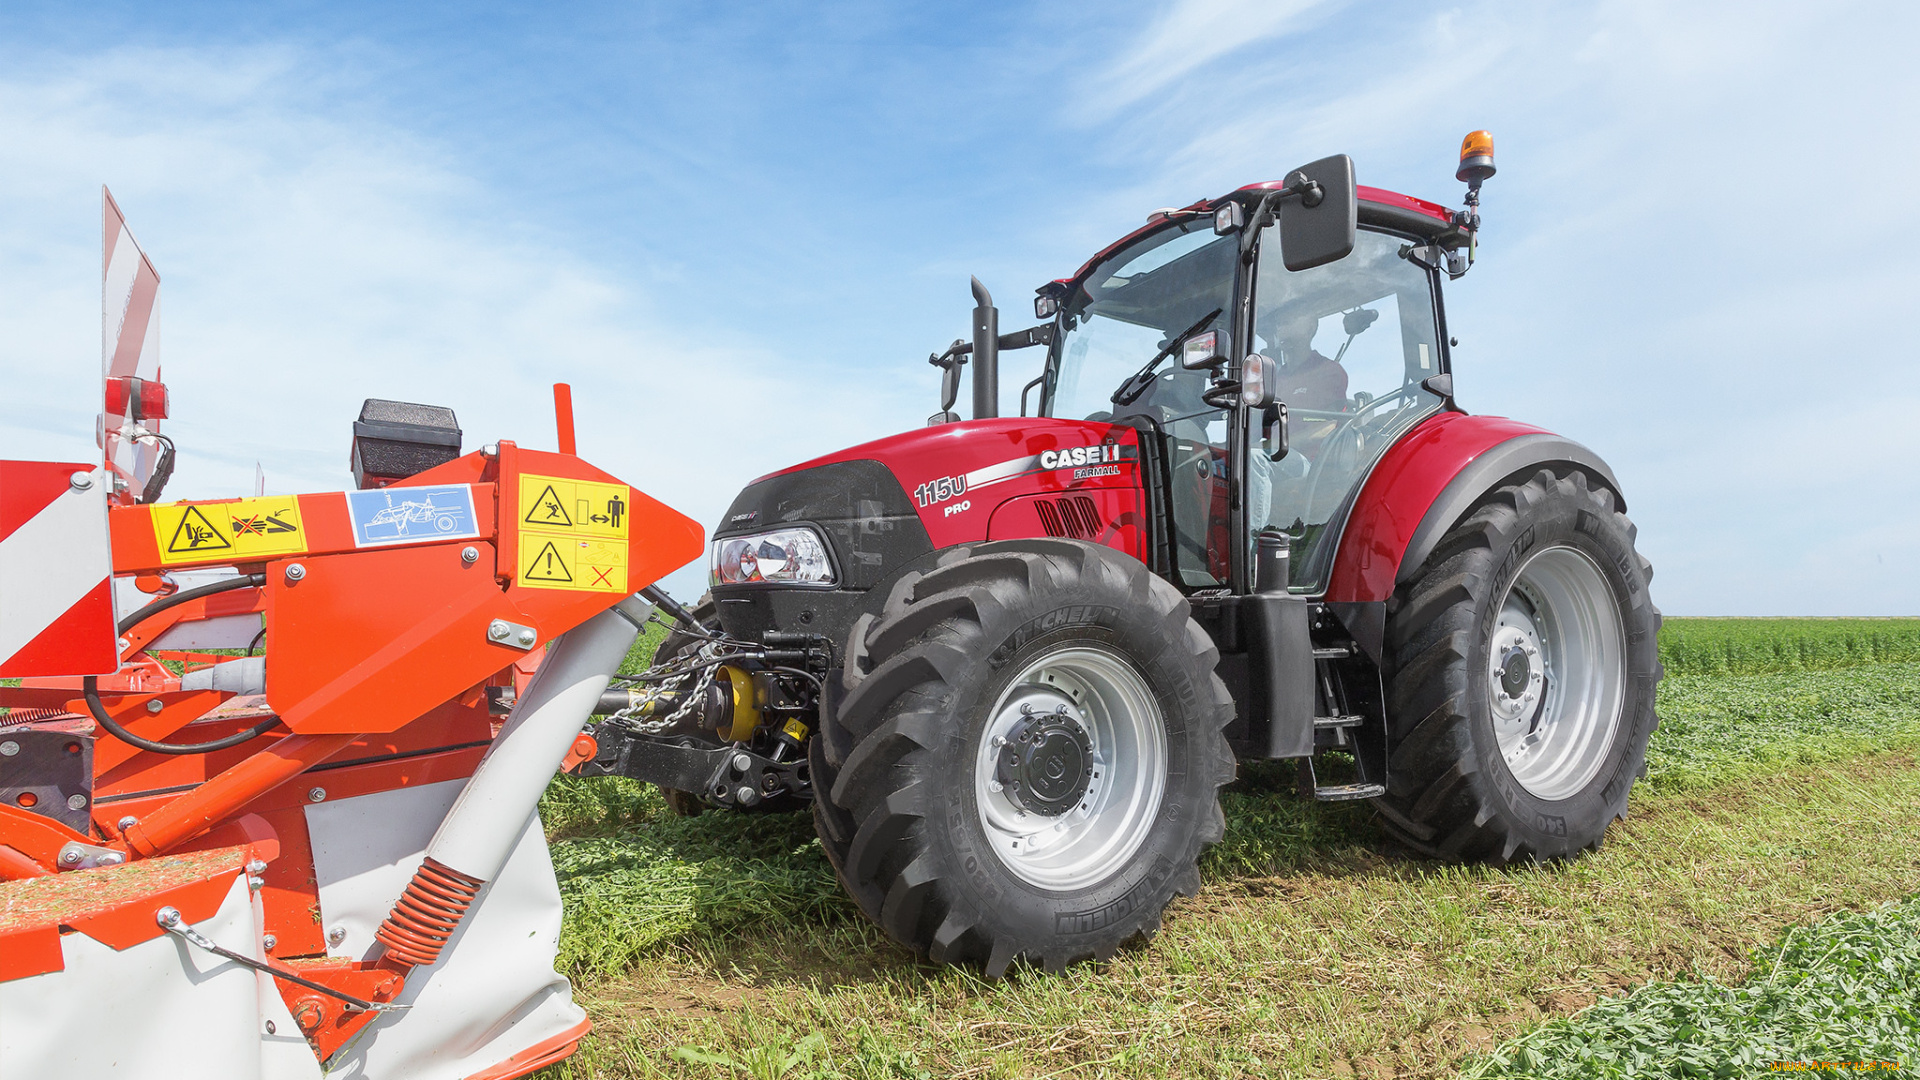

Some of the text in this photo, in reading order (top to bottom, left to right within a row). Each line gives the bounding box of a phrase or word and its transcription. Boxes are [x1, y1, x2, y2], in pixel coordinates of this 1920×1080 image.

[1040, 445, 1100, 470] CASE
[1074, 465, 1121, 479] FARMALL
[914, 474, 967, 508] 115U
[943, 500, 972, 518] PRO
[1014, 604, 1117, 647] MICHELIN
[1056, 878, 1154, 934] MICHELIN
